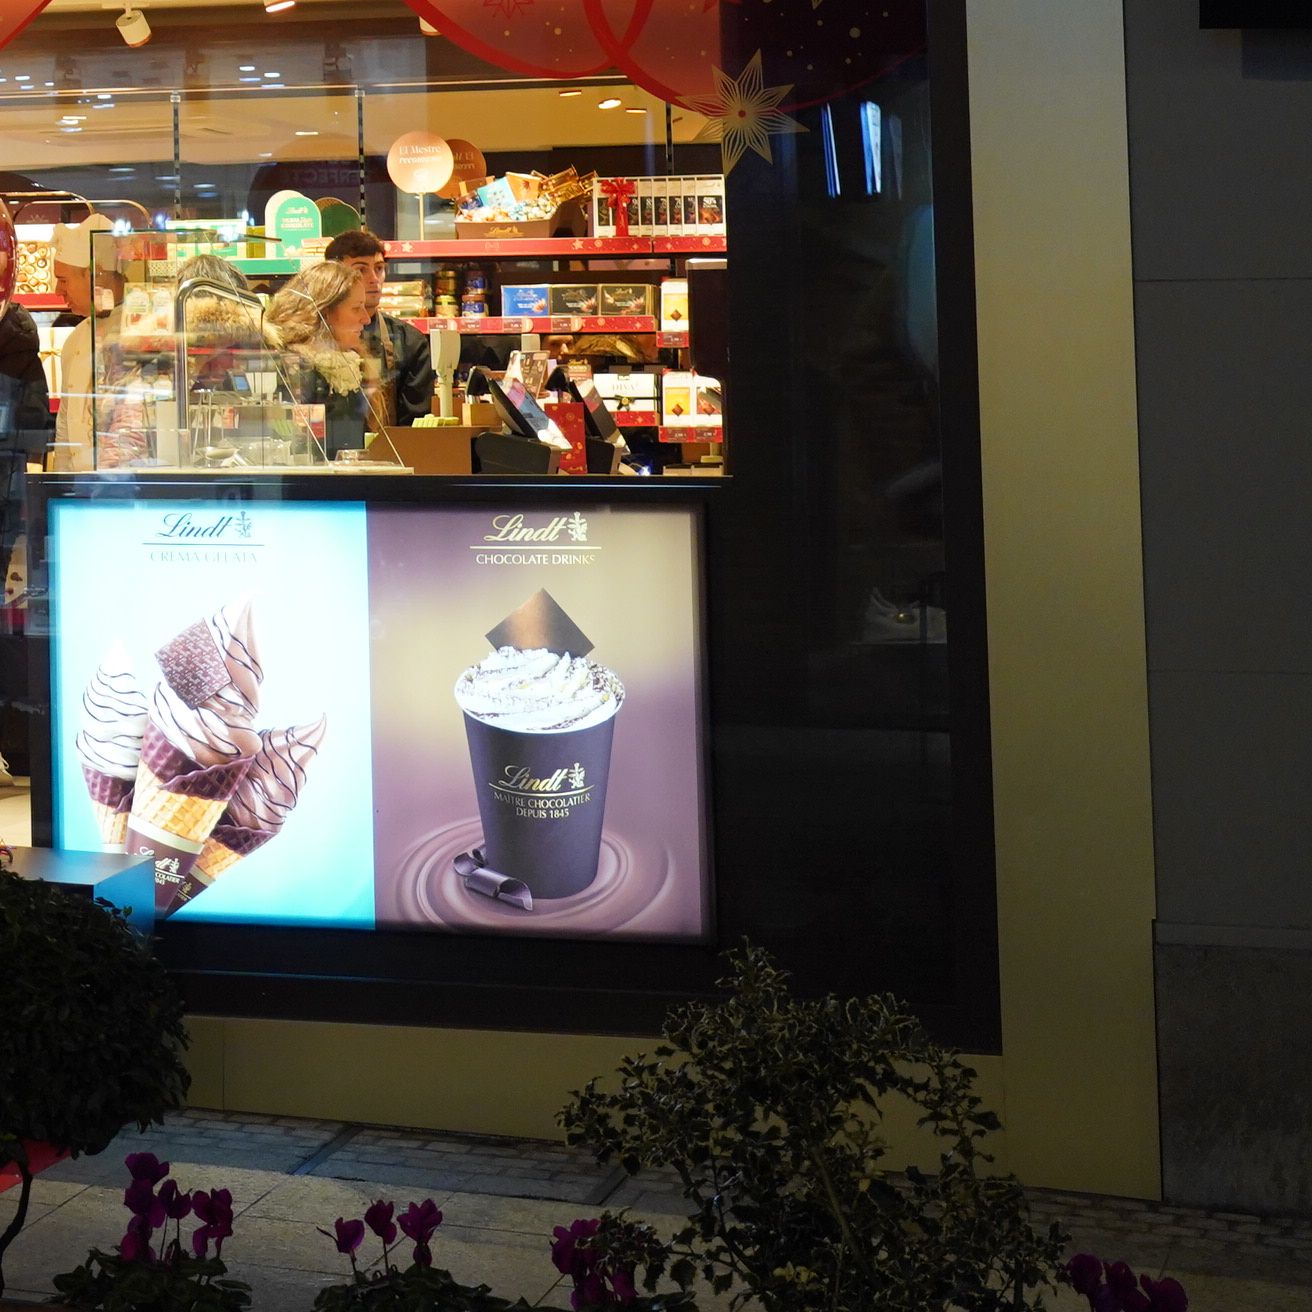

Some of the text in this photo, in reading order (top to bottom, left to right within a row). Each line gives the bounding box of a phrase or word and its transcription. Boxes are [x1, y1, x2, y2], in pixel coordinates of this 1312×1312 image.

[155, 512, 233, 538] Lindt
[484, 513, 566, 542] Lindt
[476, 553, 596, 566] CHOCOLATE DRINKS
[498, 765, 569, 792] Lindt
[527, 792, 592, 809] CHOCOLATIER
[516, 808, 570, 819] DEPUIS 1845
